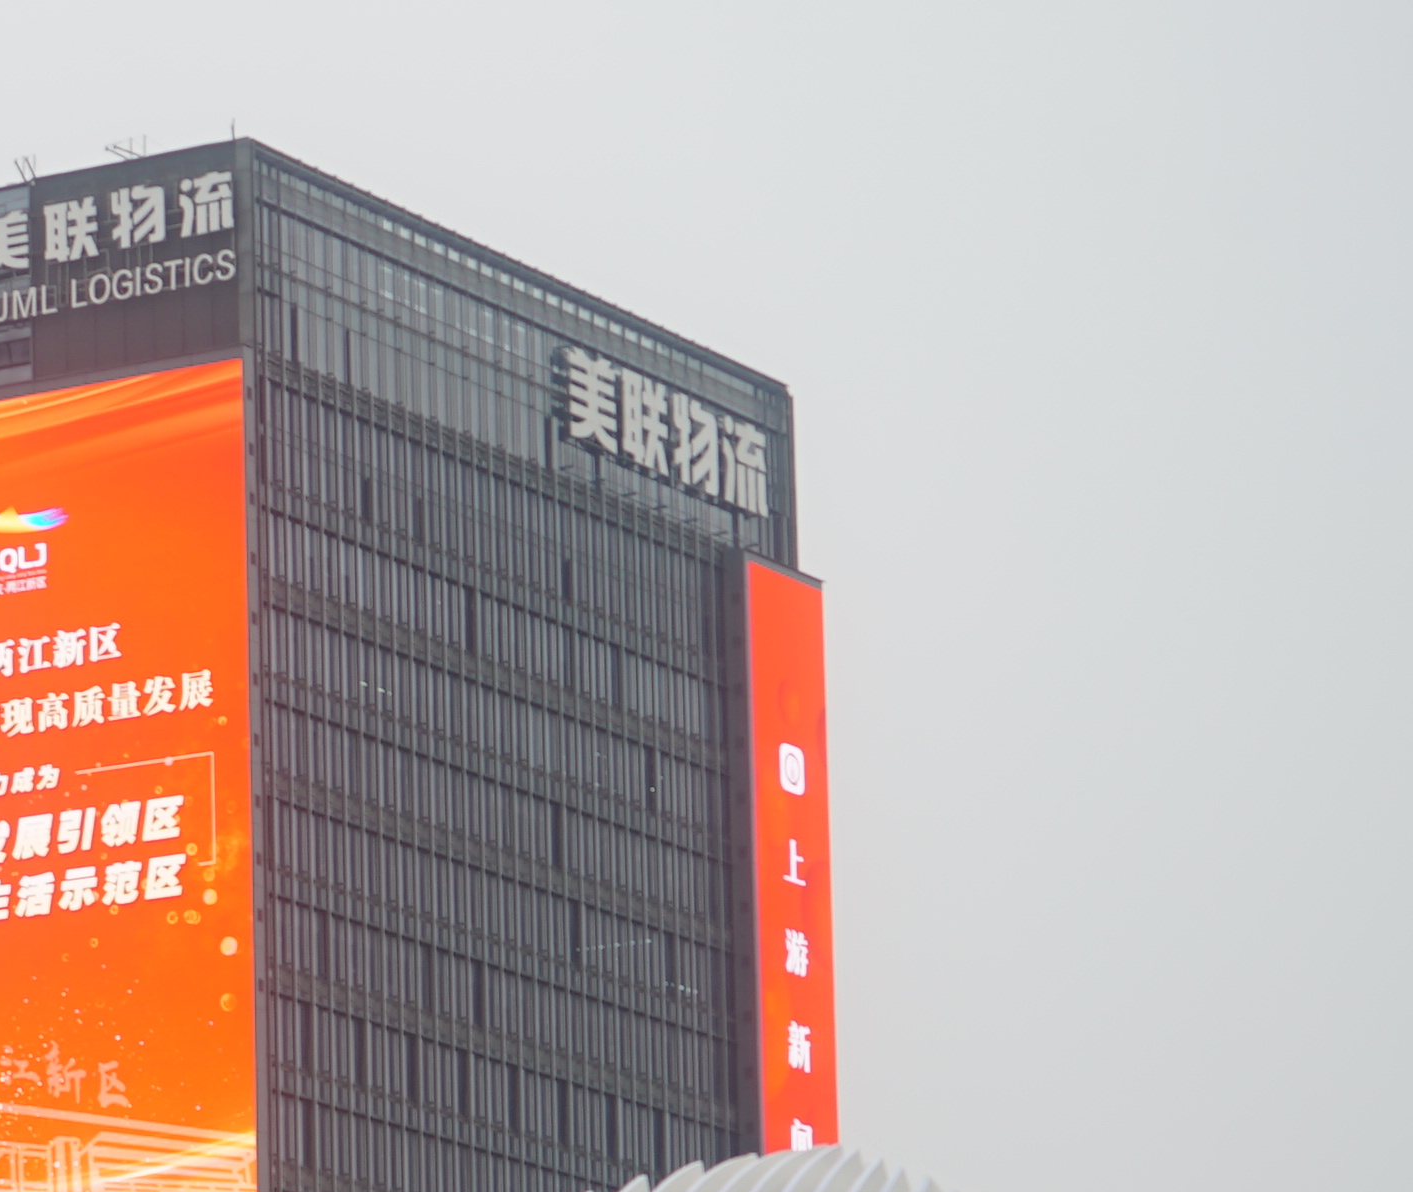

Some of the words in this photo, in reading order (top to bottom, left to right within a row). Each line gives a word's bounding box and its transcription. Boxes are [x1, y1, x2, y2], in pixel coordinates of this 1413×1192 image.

[71, 249, 236, 308] LOGISTICS
[566, 348, 769, 518] 美联物流
